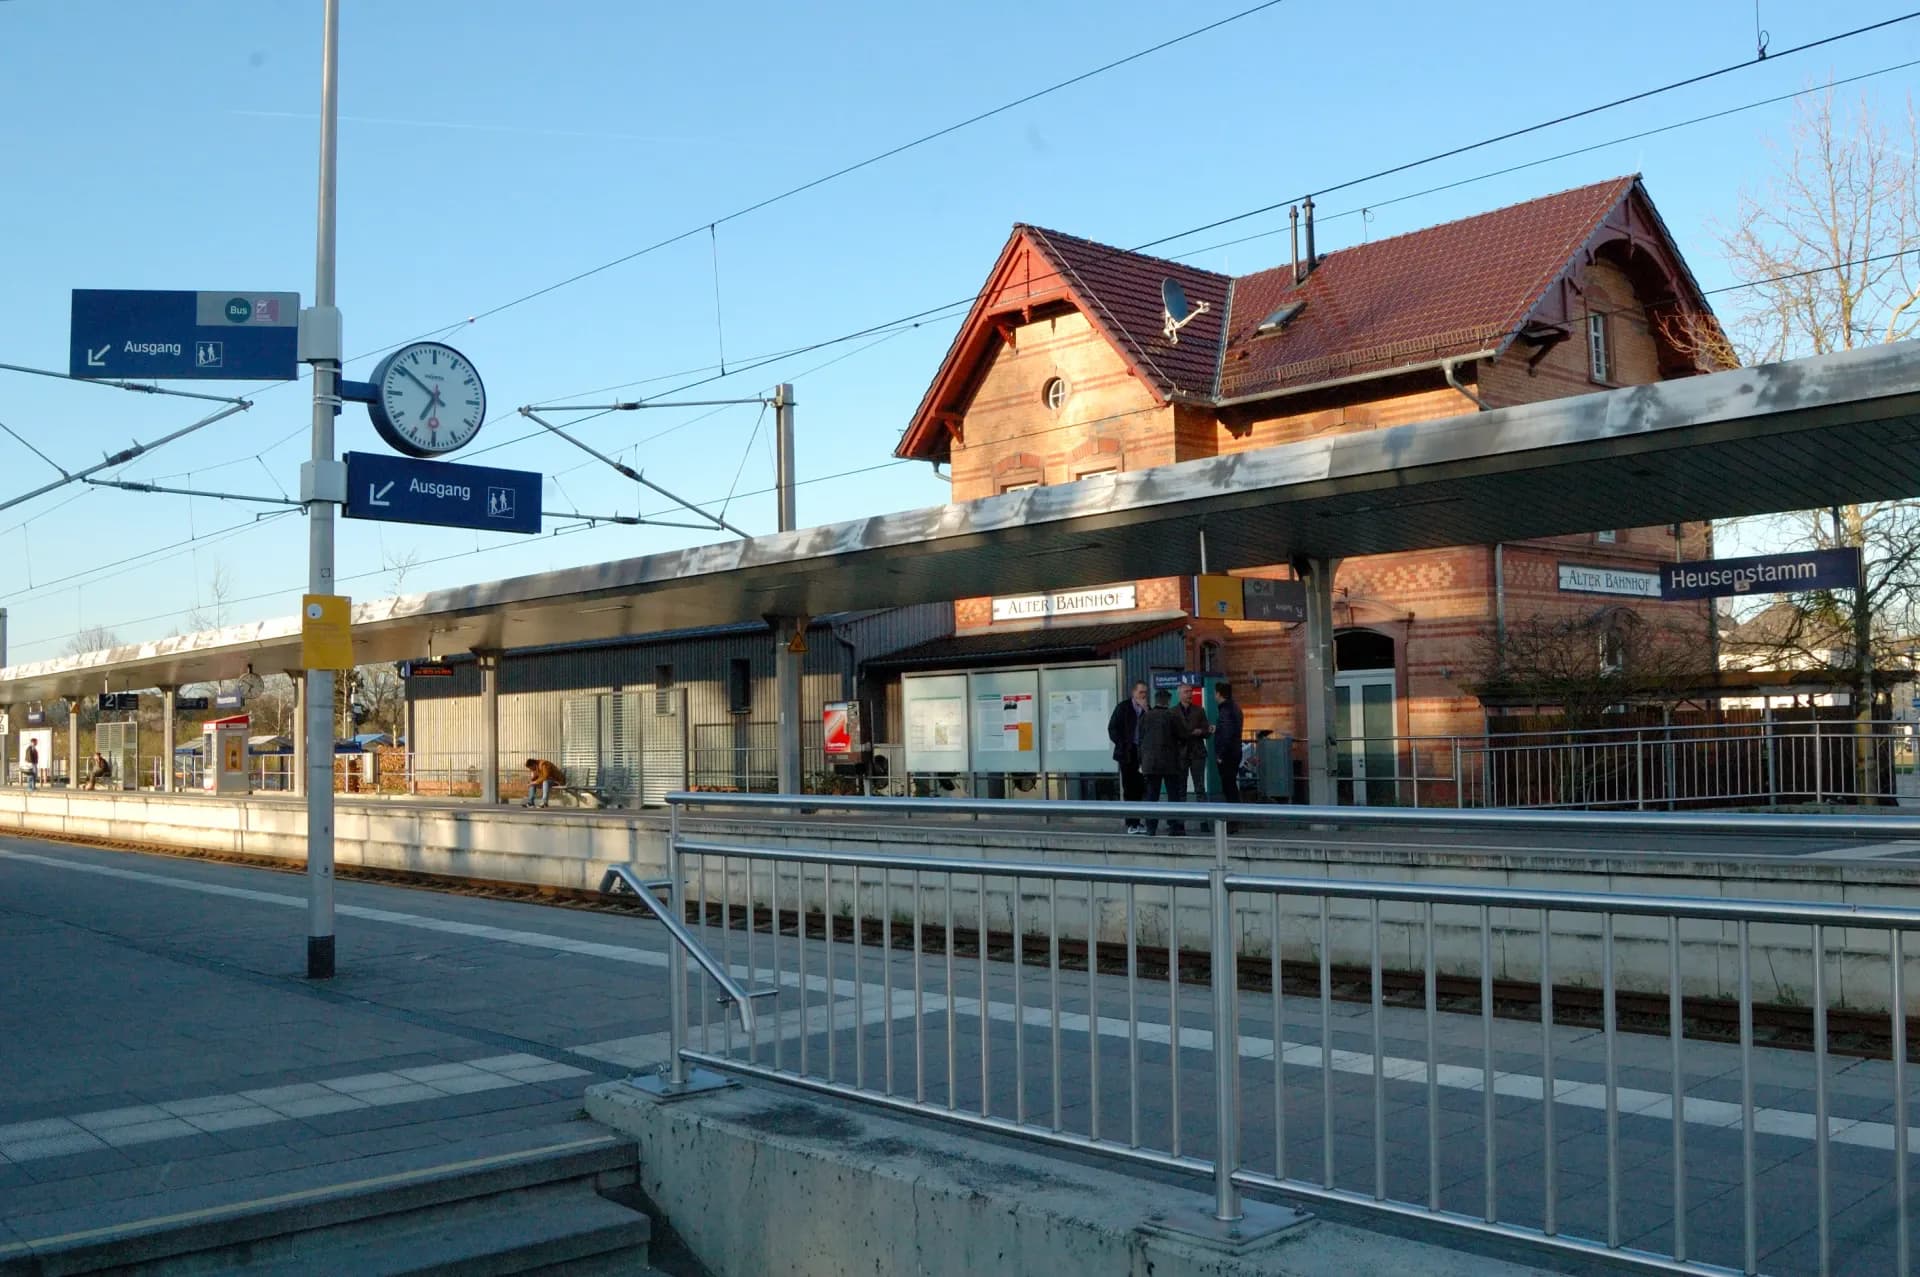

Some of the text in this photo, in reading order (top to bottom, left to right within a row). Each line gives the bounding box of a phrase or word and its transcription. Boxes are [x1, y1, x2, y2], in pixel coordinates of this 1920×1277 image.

[230, 306, 248, 315] Bus
[124, 340, 181, 356] Ausgang
[409, 478, 471, 501] Ausgang
[1568, 569, 1650, 592] ALTER BAHNHOF
[1671, 562, 1817, 589] Heusenstamm
[1008, 593, 1121, 615] ALTER BAHNHOF
[105, 694, 115, 707] 2
